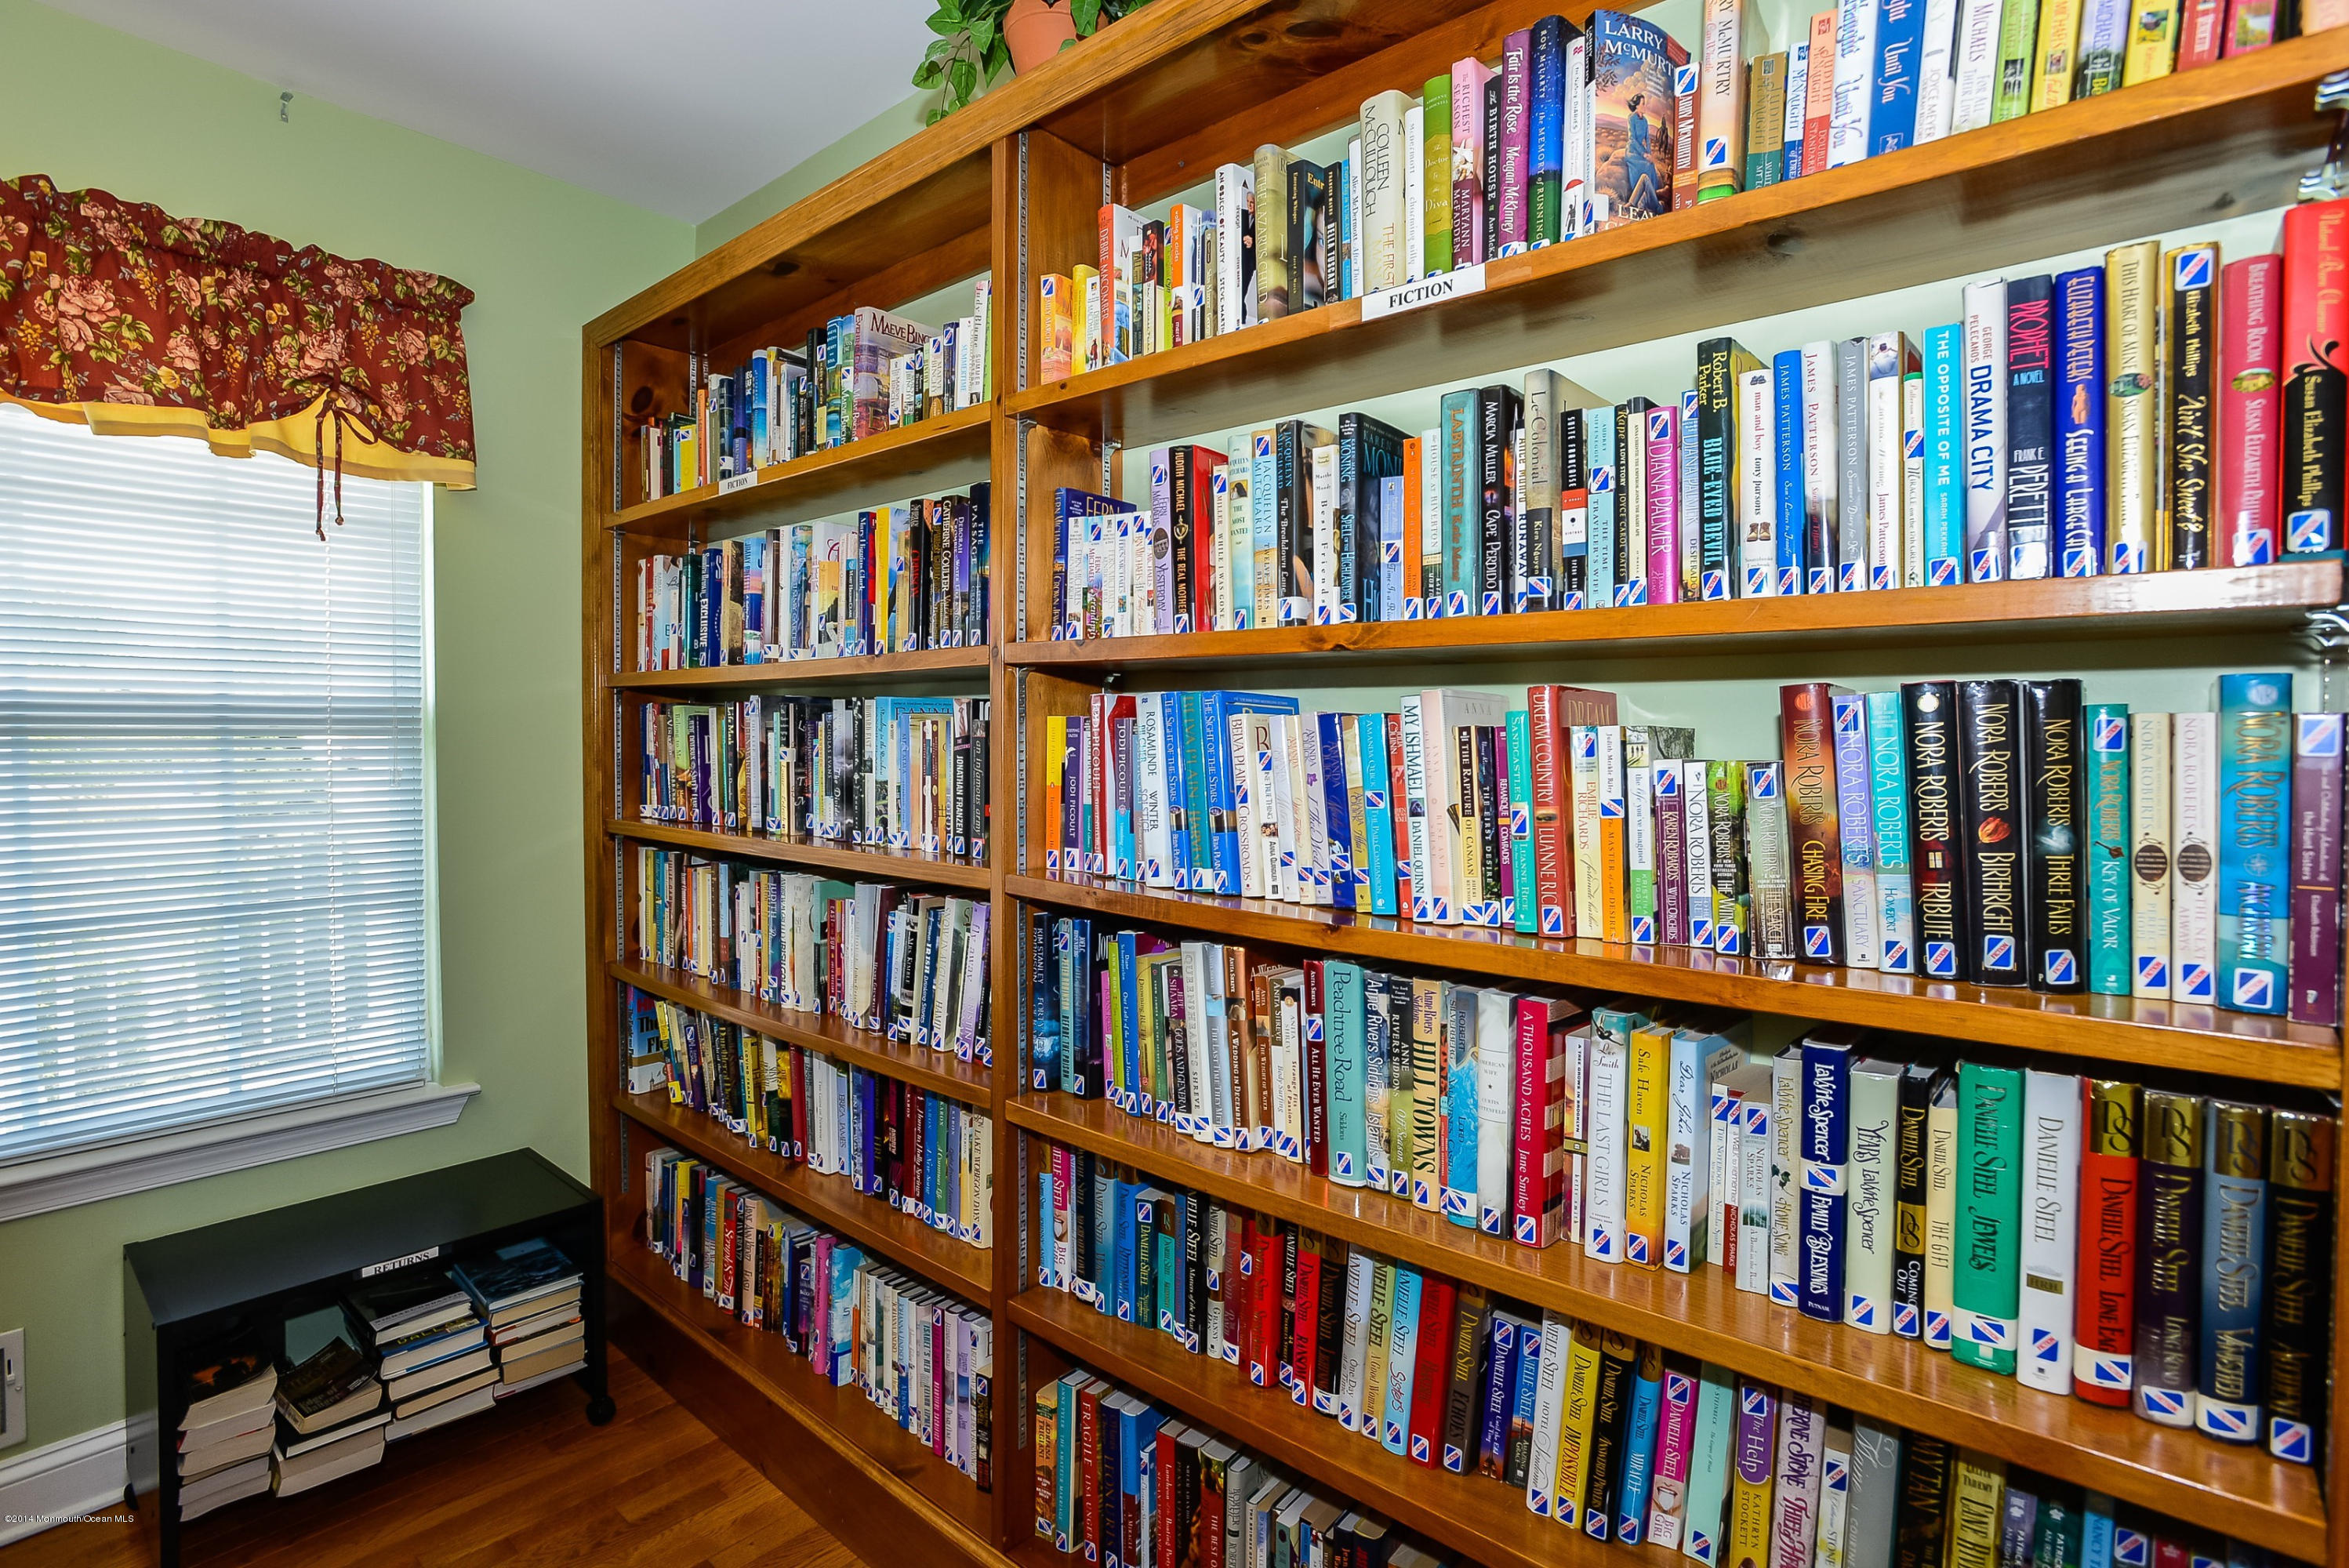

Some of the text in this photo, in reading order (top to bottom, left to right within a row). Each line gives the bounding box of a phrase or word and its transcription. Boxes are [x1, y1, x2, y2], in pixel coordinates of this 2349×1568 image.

[1605, 20, 1662, 50] LARRY
[1715, 20, 1734, 96] McMURTRY
[1505, 49, 1523, 134] Fair Is the Rose
[1878, 38, 1912, 103] Until You
[1453, 84, 1461, 129] SEASON
[1489, 107, 1498, 152] BIRTH
[1218, 172, 1225, 183] AN
[1364, 107, 1376, 217] McCULLOUGH
[1377, 123, 1389, 191] COLLEEN
[1487, 155, 1497, 200] HOUSE
[1537, 126, 1545, 174] MEMORY
[1453, 189, 1461, 252] McFADDEN
[1501, 146, 1521, 234] Meagan McKinney
[1219, 219, 1225, 228] OF
[1257, 174, 1268, 303] THE LAZARUS CHILD
[1100, 227, 1109, 321] DEBBIE MACOMBER
[1389, 279, 1453, 308] FICTION
[1970, 314, 1980, 363] PELECANOS
[1982, 326, 1992, 360] GEORGE
[2010, 299, 2049, 370] PROPHET
[1698, 365, 1712, 405] Parker
[1711, 351, 1728, 412] Robert B.
[1937, 330, 1951, 486] THE OPPOSITE OF ME
[1752, 432, 1765, 451] boy
[1755, 414, 1763, 429] and
[1780, 365, 1791, 470] JAMES PATTERSON
[1970, 365, 1994, 491] DRAMA CITY
[2297, 376, 2325, 506] Susan Elizabeth Phillips
[728, 477, 748, 489] FICTION
[1450, 408, 1464, 509] LABYRINTH
[1752, 457, 1764, 515] tony parsons
[1485, 401, 1501, 589] MARCIA MULLER CAPE PERDIDO
[1703, 438, 1724, 565] BLUE-EYED DEVIL
[2008, 464, 2049, 534] PERETTI
[942, 500, 951, 591] CATHERINE COULTER
[1175, 452, 1187, 614] JUDITH MICHAEL THE REAL MOTHER
[1878, 493, 1890, 565] James Patterson
[699, 598, 708, 648] EXCLUSIVE
[975, 740, 981, 753] an
[1117, 724, 1127, 802] JODI PICOULT
[1146, 712, 1156, 776] ROSAMUNDE
[1510, 717, 1523, 803] SANDCASTLES
[974, 758, 984, 804] infamous
[1149, 790, 1158, 830] WINTER
[1231, 719, 1251, 880] BELVA PLAIN CROSSROADS
[1404, 705, 1425, 894] MY ISHMAEL DANIEL QUINN
[1533, 694, 1557, 878] DREAM COUNTRY LUANNE
[1909, 721, 1948, 841] NORA ROBERTS
[1315, 873, 1328, 884] FICTION
[1802, 840, 1828, 920] CHASING FIRE
[1920, 880, 1952, 938] TRIBUTE
[1977, 852, 2016, 933] BIRTHRIGHT
[2046, 853, 2076, 935] THREE FATES
[1697, 927, 1710, 942] FICTION
[1332, 971, 1352, 1102] Peachtree Road
[1366, 979, 1383, 1103] Anne Rivers Siddons
[1412, 1040, 1436, 1173] HILL TOWNS
[1517, 1011, 1534, 1211] A THOUSAND ACRES Jane Smiley
[1636, 1048, 1650, 1115] Safe Haven
[1338, 1112, 1348, 1141] Siddons
[1367, 1113, 1383, 1156] Islands
[1853, 1120, 1889, 1163] YEARS
[1629, 1170, 1639, 1207] SPARKS
[1639, 1164, 1651, 1216] NICHOLAS
[1814, 1170, 1833, 1185] FICTION
[2034, 1116, 2064, 1243] DANIELLE STEEL
[375, 1252, 429, 1274] RETURNS
[1808, 1194, 1834, 1294] FAMILY BLESSINGS
[1389, 1362, 1407, 1413] Sisters
[1449, 1389, 1471, 1440] ECHOES
[1081, 1402, 1095, 1540] FRAGILE LISA UNGER
[1558, 1425, 1581, 1497] IMPOSSIBLE
[1662, 1403, 1686, 1476] DANIELLE STEEL
[1743, 1415, 1766, 1472] The Help
[1739, 1490, 1752, 1547] STOCKETT
[1750, 1493, 1763, 1550] KATHRYN
